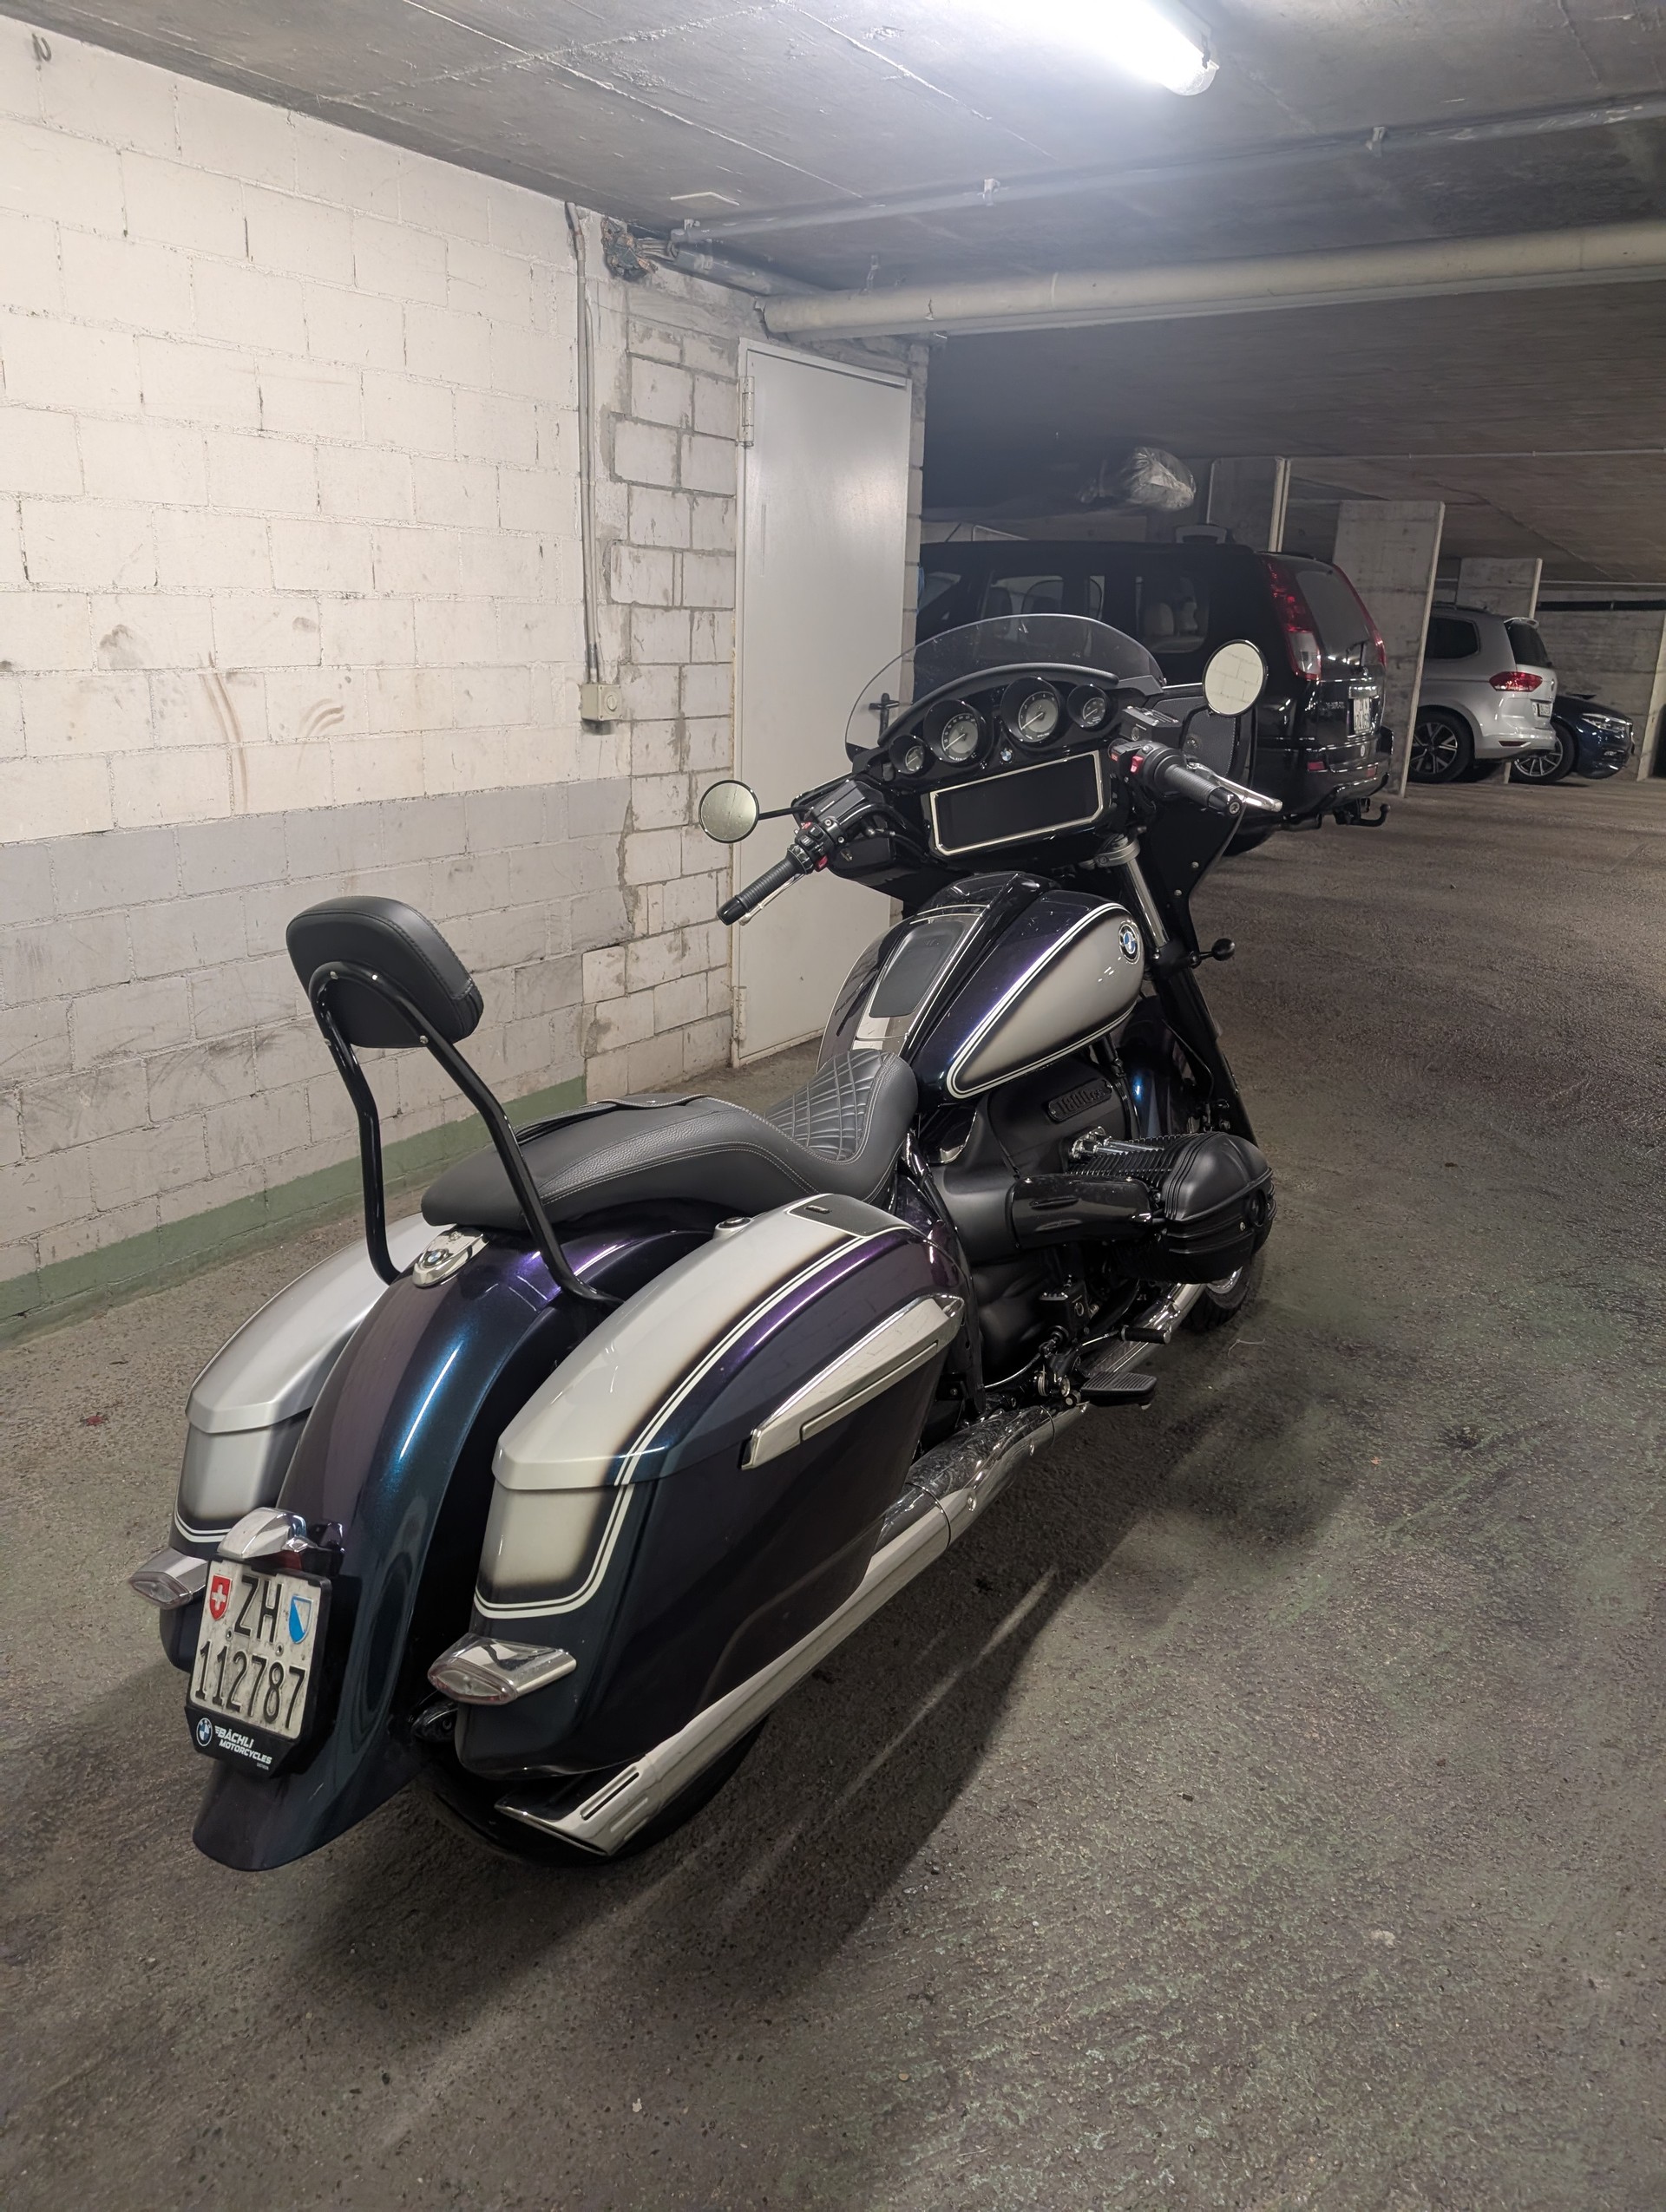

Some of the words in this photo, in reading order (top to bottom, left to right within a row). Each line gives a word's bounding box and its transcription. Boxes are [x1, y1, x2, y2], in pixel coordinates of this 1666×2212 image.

[234, 1574, 282, 1643] ZH
[194, 1640, 305, 1730] 112787
[219, 1739, 272, 1764] MOTORCYCLES
